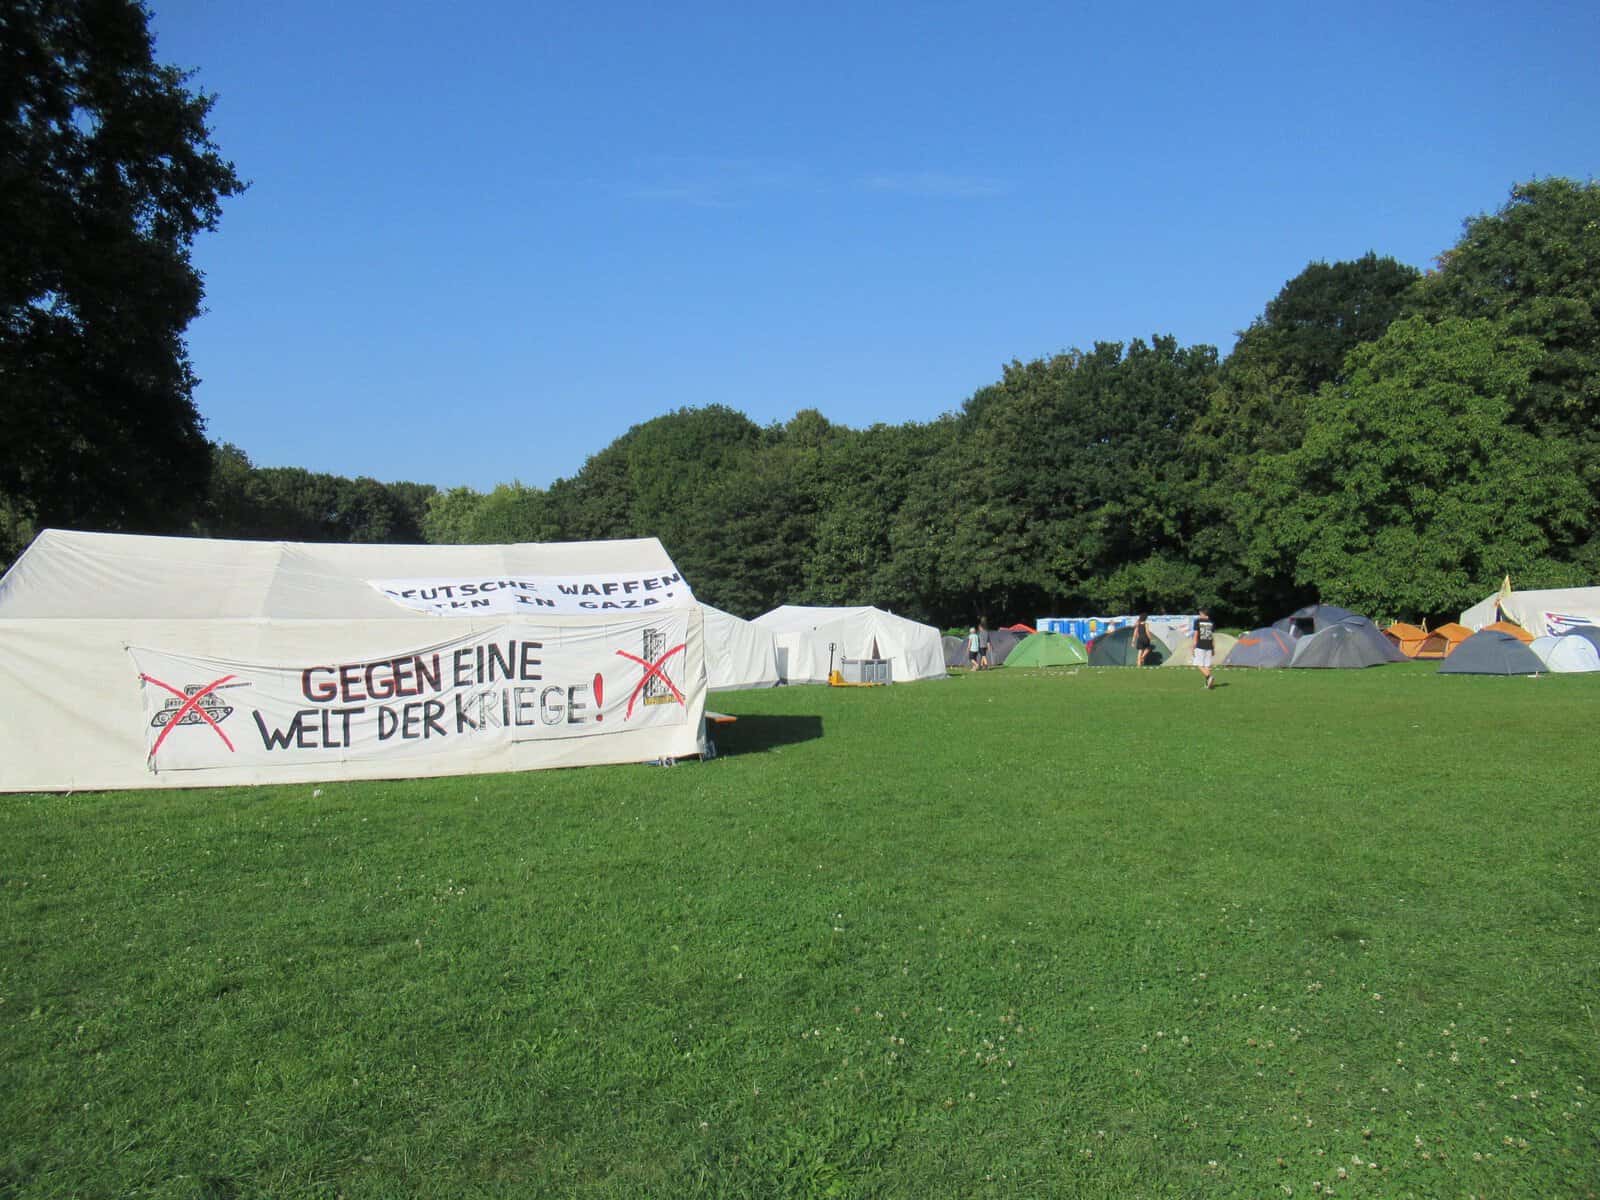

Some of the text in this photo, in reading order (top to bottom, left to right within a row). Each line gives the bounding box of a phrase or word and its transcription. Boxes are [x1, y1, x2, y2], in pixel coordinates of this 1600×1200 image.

[385, 573, 681, 600] EUTSCHE WAFFEN
[515, 594, 555, 607] IN
[302, 640, 543, 703] GEGEN EINE
[252, 672, 604, 750] WELT DER KRIEGE!
